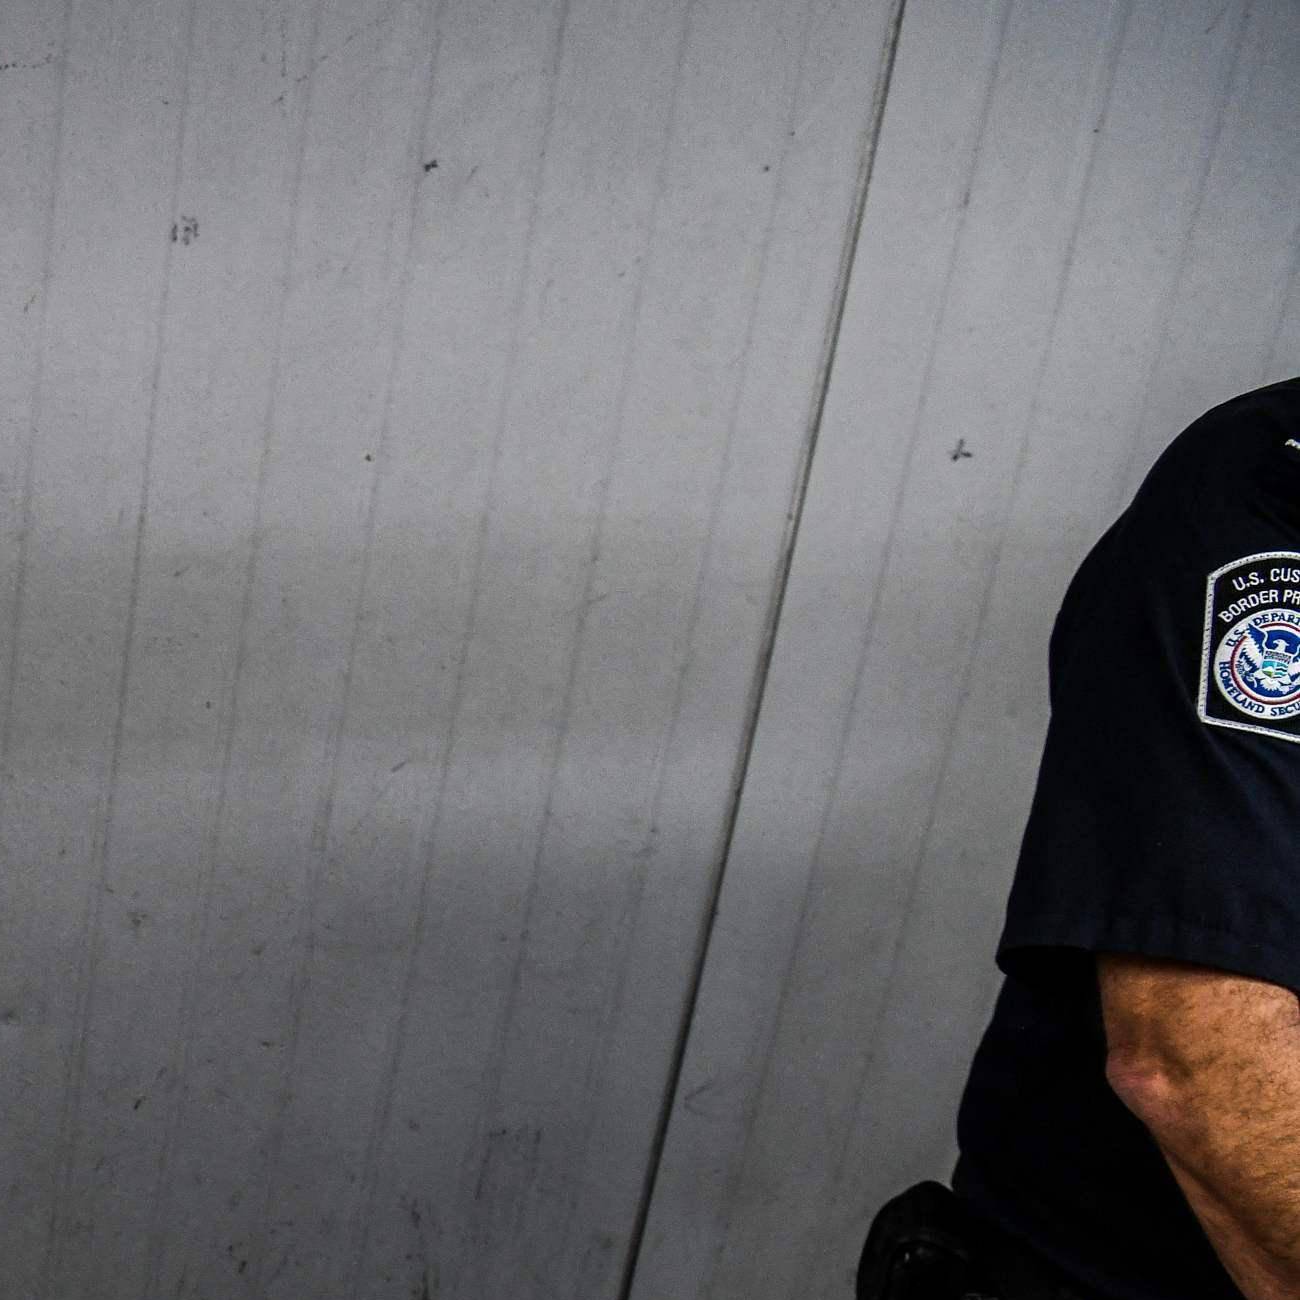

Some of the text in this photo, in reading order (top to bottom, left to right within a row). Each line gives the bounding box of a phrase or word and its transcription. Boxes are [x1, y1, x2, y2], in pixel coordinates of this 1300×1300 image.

[1232, 567, 1300, 591] U.S. CUS
[1217, 589, 1279, 623] BORDER
[1218, 661, 1265, 714] HOMELAND
